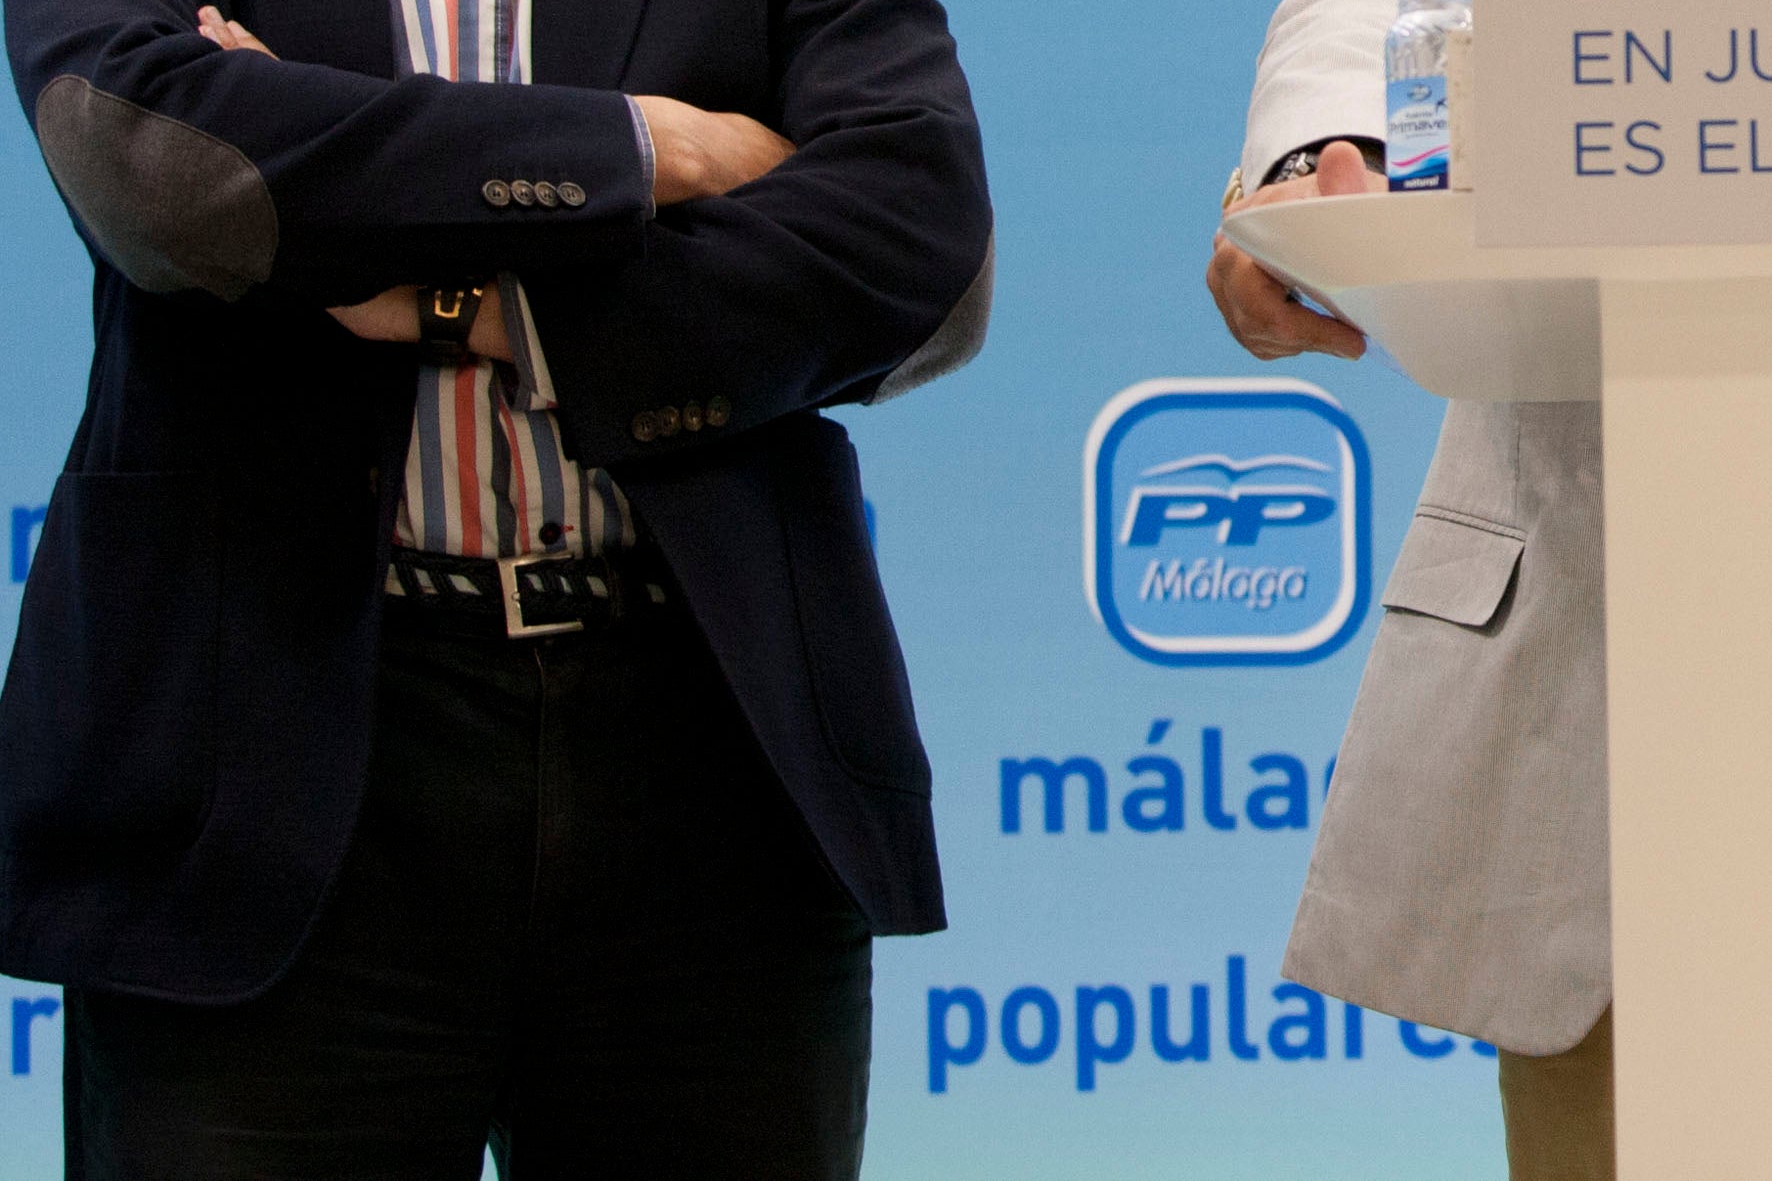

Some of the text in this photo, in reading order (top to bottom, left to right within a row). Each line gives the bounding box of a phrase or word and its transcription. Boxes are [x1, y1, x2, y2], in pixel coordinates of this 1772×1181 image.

[1574, 30, 1671, 85] EN
[1576, 120, 1664, 175] ES
[1120, 486, 1335, 546] PP
[1139, 557, 1307, 608] Málaga
[1001, 719, 1336, 834] mála
